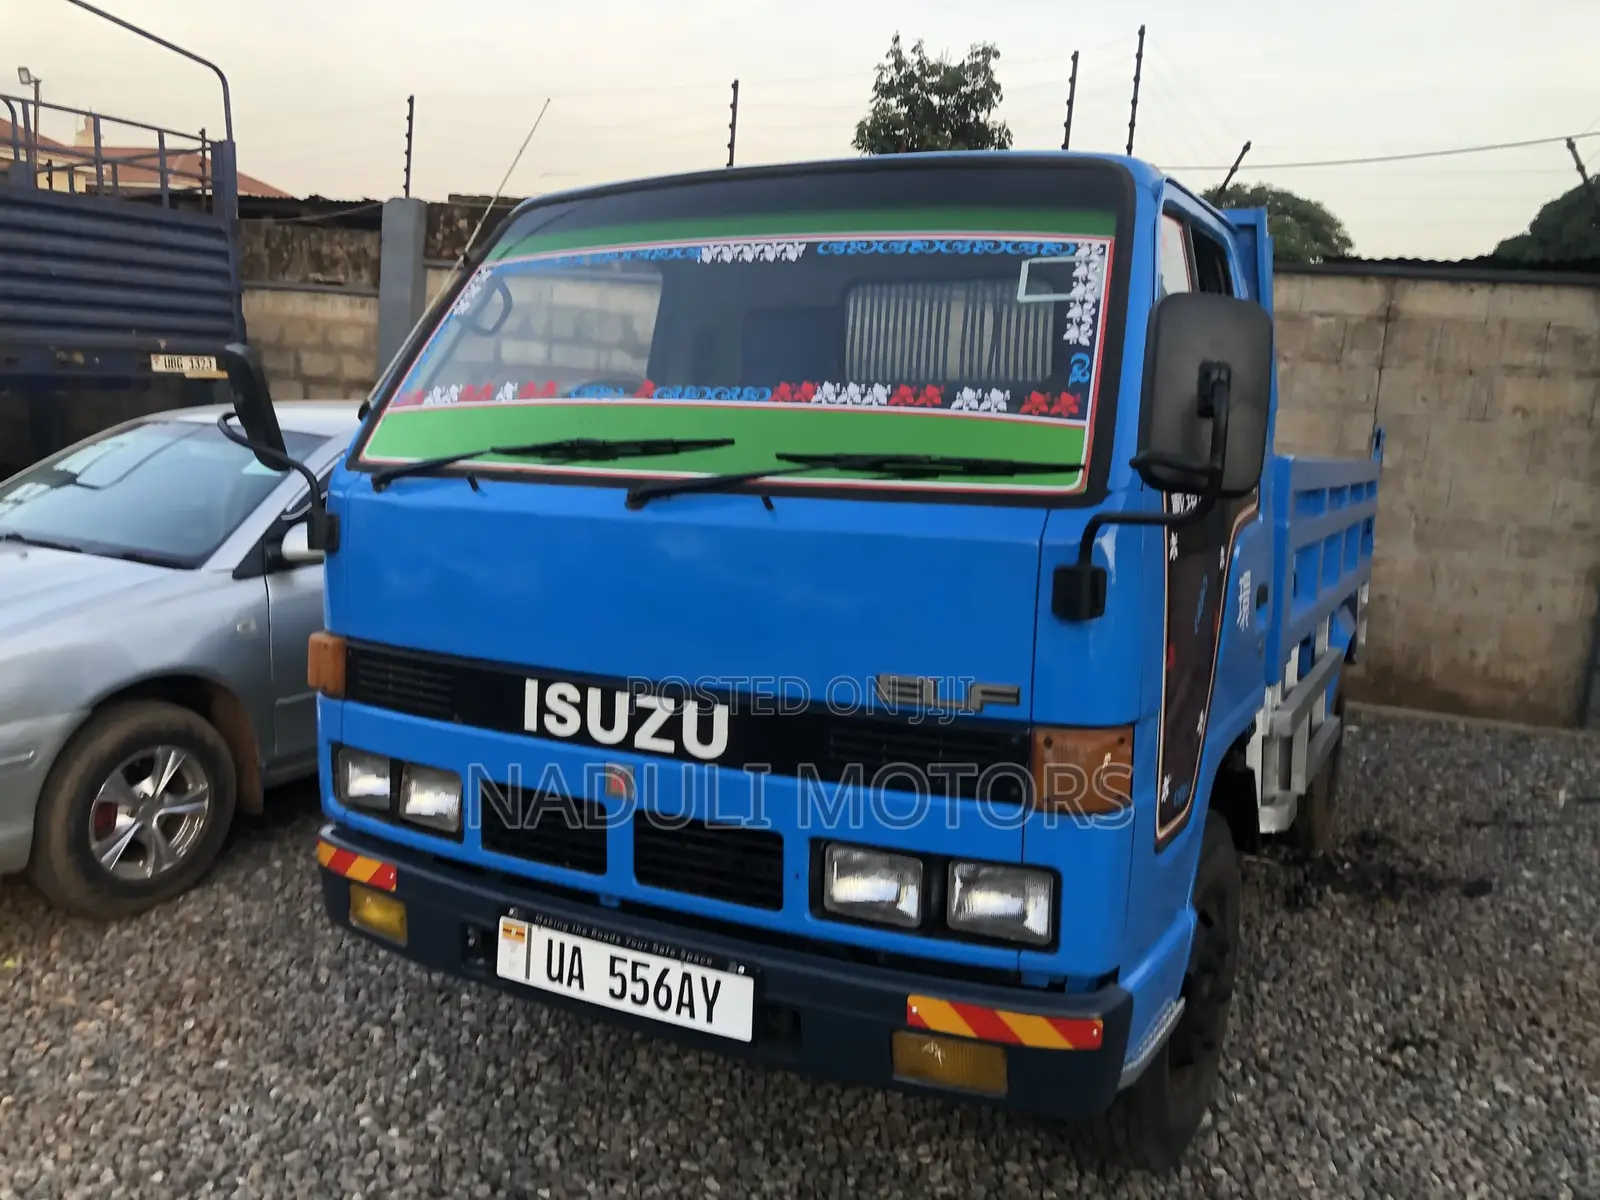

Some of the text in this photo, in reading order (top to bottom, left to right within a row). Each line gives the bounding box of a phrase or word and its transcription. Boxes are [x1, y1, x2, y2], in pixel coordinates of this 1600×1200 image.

[523, 677, 730, 760] ISUZU
[534, 913, 568, 932] Making
[572, 923, 588, 936] the
[591, 927, 621, 945] Roads
[546, 938, 722, 1024] UA 556AY
